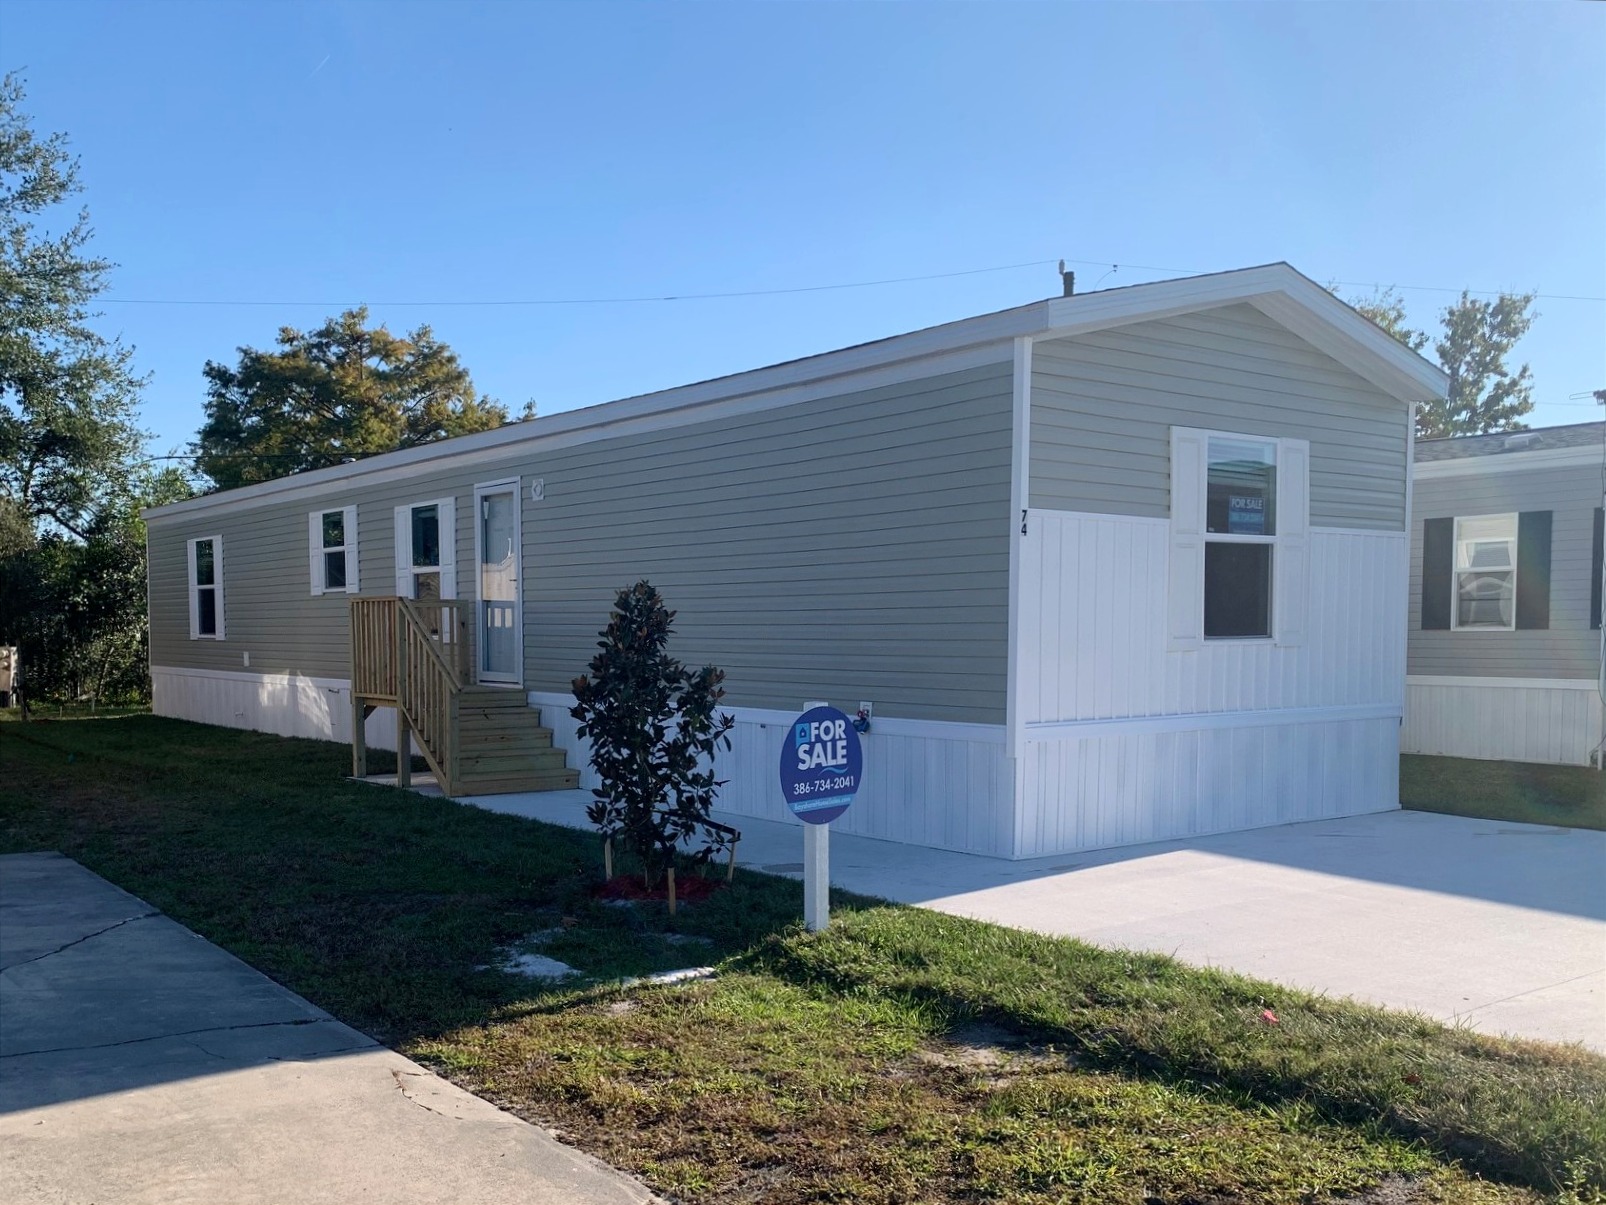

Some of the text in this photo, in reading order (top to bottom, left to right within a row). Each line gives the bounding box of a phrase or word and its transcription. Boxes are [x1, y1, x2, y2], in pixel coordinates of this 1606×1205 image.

[1231, 498, 1263, 510] FOR SALE
[810, 719, 847, 742] FOR
[797, 740, 847, 771] SALE
[793, 775, 854, 795] 386-734-2041
